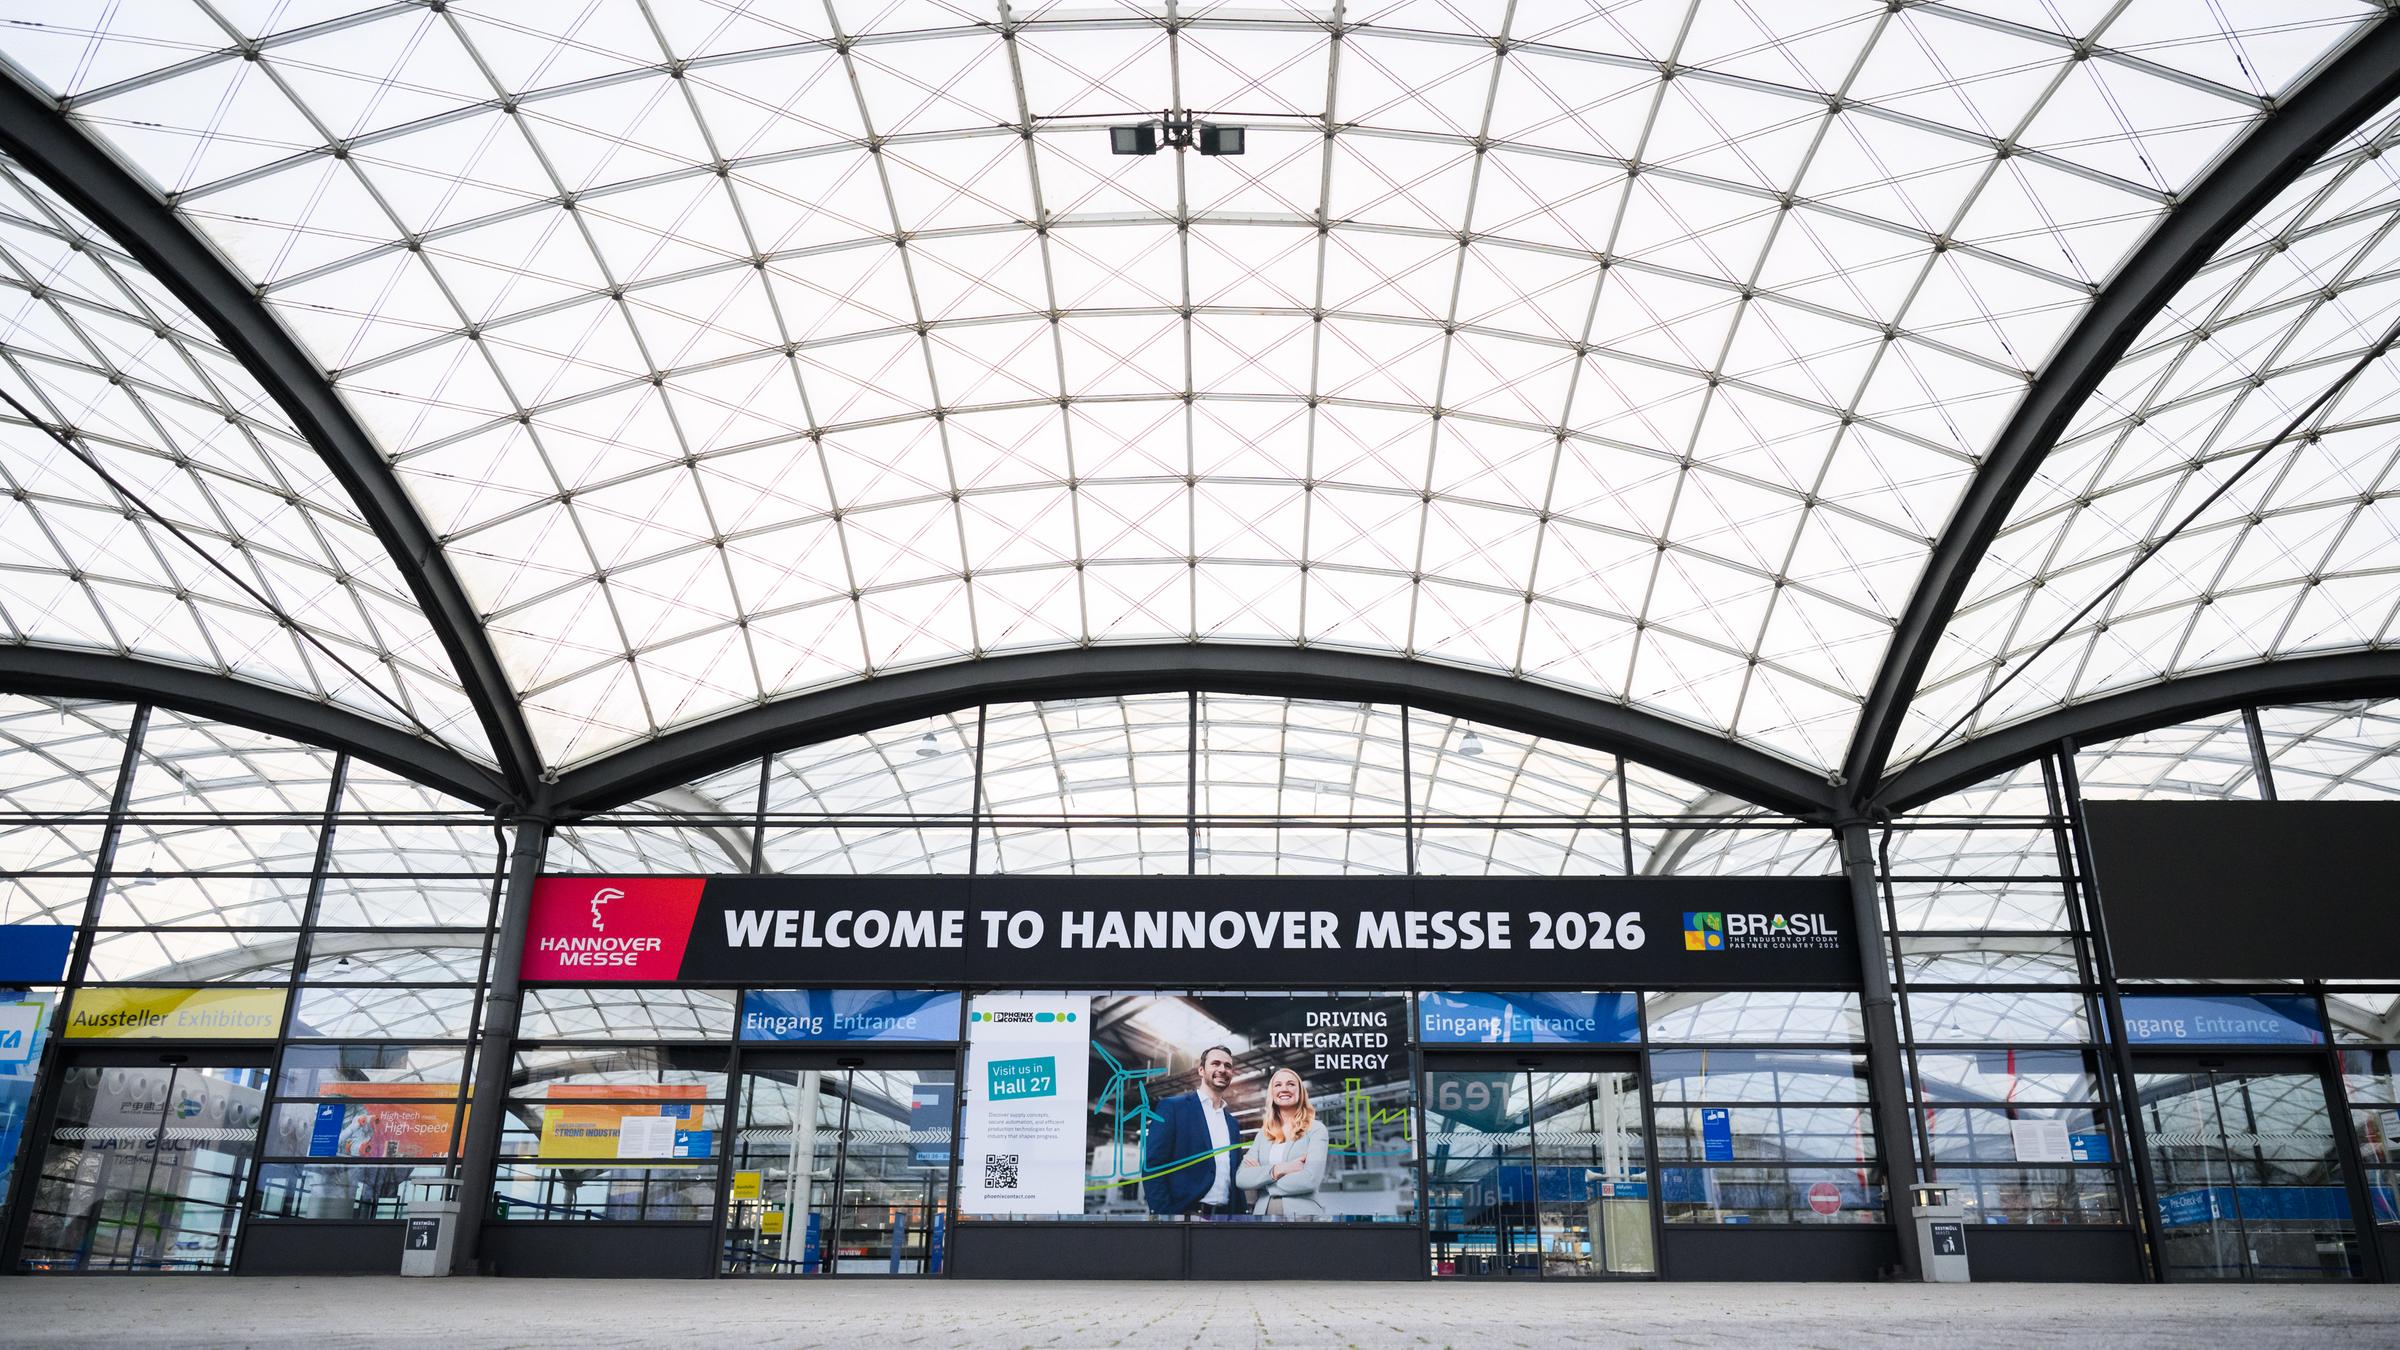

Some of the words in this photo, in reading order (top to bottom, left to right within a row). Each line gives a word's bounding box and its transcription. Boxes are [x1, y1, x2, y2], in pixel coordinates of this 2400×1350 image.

[724, 909, 965, 949] WELCOME
[981, 910, 1045, 949] TO
[1061, 910, 1342, 950] HANNOVER
[1355, 911, 1512, 950] MESSE
[1528, 911, 1646, 951] 2026
[1726, 913, 1838, 936] BRASIL
[540, 937, 662, 952] HANNOVER
[559, 952, 638, 966] MESSE
[73, 1009, 169, 1028] Aussteller
[176, 1009, 273, 1028] Exhibitors
[746, 1012, 824, 1036] Eingang
[833, 1012, 918, 1031] Entrance
[1306, 1011, 1388, 1027] DRIVING
[1424, 1013, 1502, 1037] Eingang
[1512, 1014, 1597, 1032] Entrance
[2126, 1018, 2187, 1038] ngang
[2195, 1015, 2281, 1033] Entrance
[1269, 1032, 1389, 1049] INTEGRATED
[992, 1064, 1016, 1077] Visit
[1018, 1066, 1031, 1075] us
[1033, 1063, 1043, 1073] in
[1314, 1053, 1389, 1070] ENERGY
[993, 1077, 1027, 1096] Hall
[1030, 1076, 1052, 1093] 27
[380, 1111, 421, 1122] High-tech
[384, 1121, 450, 1136] High-speed
[554, 1128, 584, 1137] STRONG
